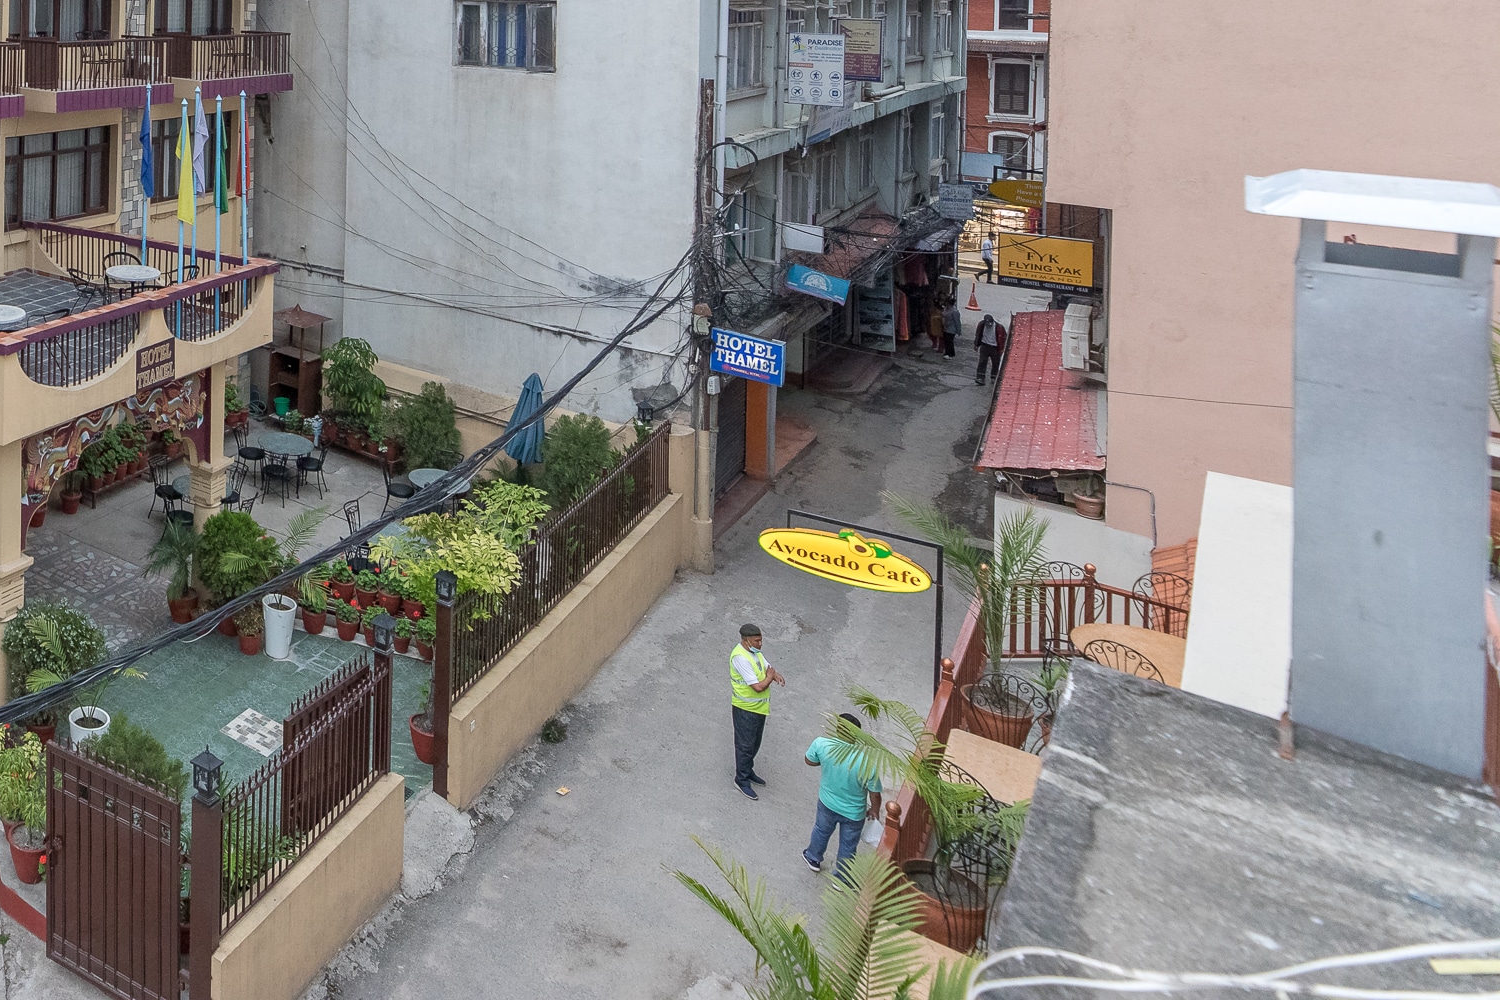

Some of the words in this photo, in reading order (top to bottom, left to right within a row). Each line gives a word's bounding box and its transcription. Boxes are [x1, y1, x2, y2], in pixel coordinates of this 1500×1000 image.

[807, 38, 843, 47] PARADISE
[1016, 188, 1033, 196] Have
[1015, 195, 1037, 205] Please
[1026, 252, 1059, 264] FYK
[1008, 260, 1053, 273] FLYING
[1056, 266, 1082, 277] YAK
[1008, 271, 1082, 284] KATHMANDU
[1045, 283, 1074, 291] RESTAURANT
[716, 332, 777, 360] HOTEL
[140, 342, 172, 369] HOTEL
[715, 347, 780, 375] THAMEL
[136, 361, 175, 390] THAMEL
[768, 538, 860, 571] Avocado
[867, 562, 921, 587] Cafe
